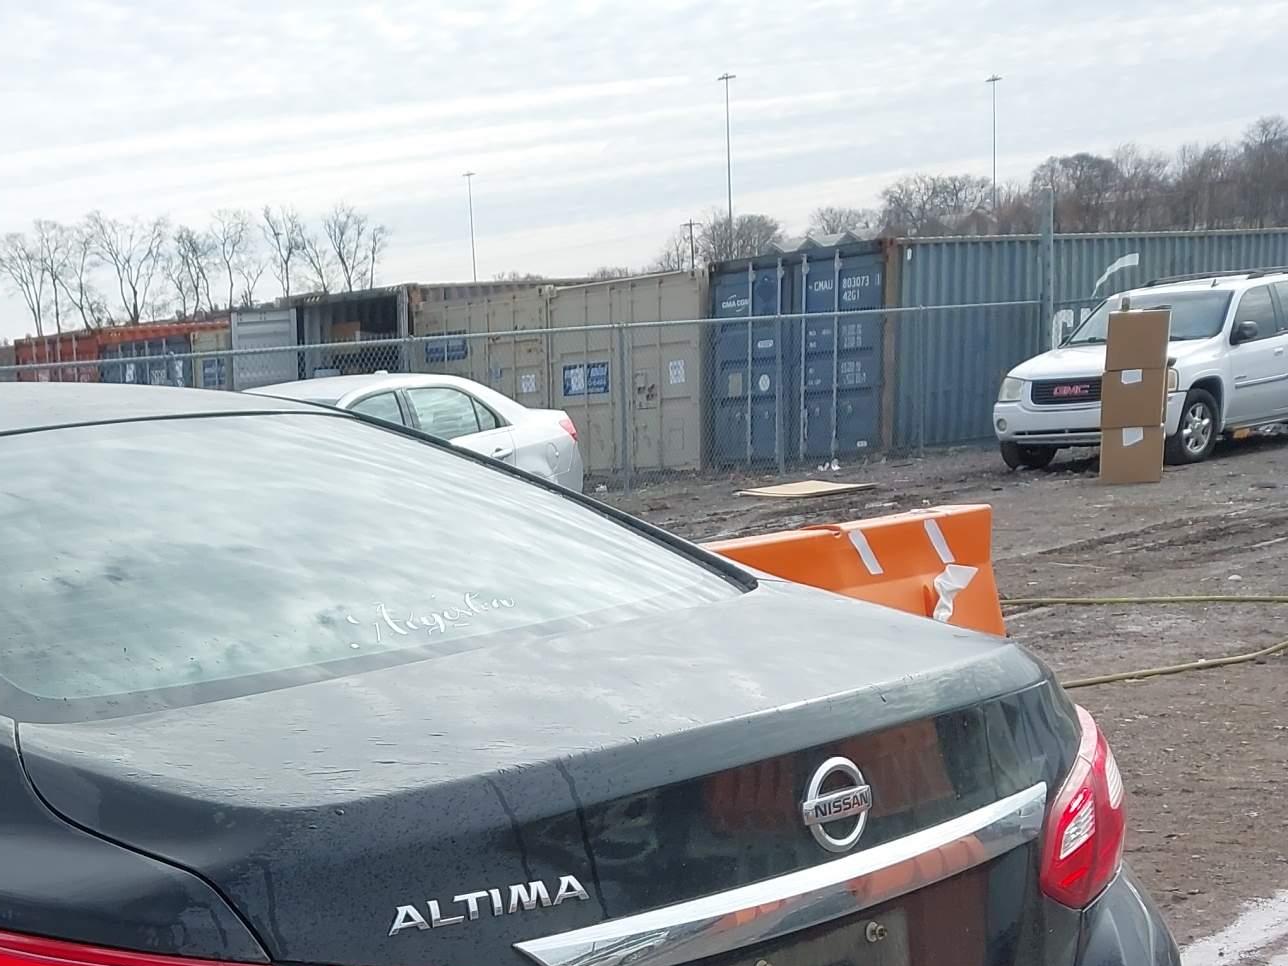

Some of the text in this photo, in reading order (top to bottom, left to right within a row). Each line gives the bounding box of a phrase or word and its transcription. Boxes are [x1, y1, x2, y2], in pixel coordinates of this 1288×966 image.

[842, 275, 870, 289] 803073
[1053, 383, 1090, 397] GMC
[814, 790, 869, 818] NISSAN
[388, 874, 591, 937] ALTIMA
